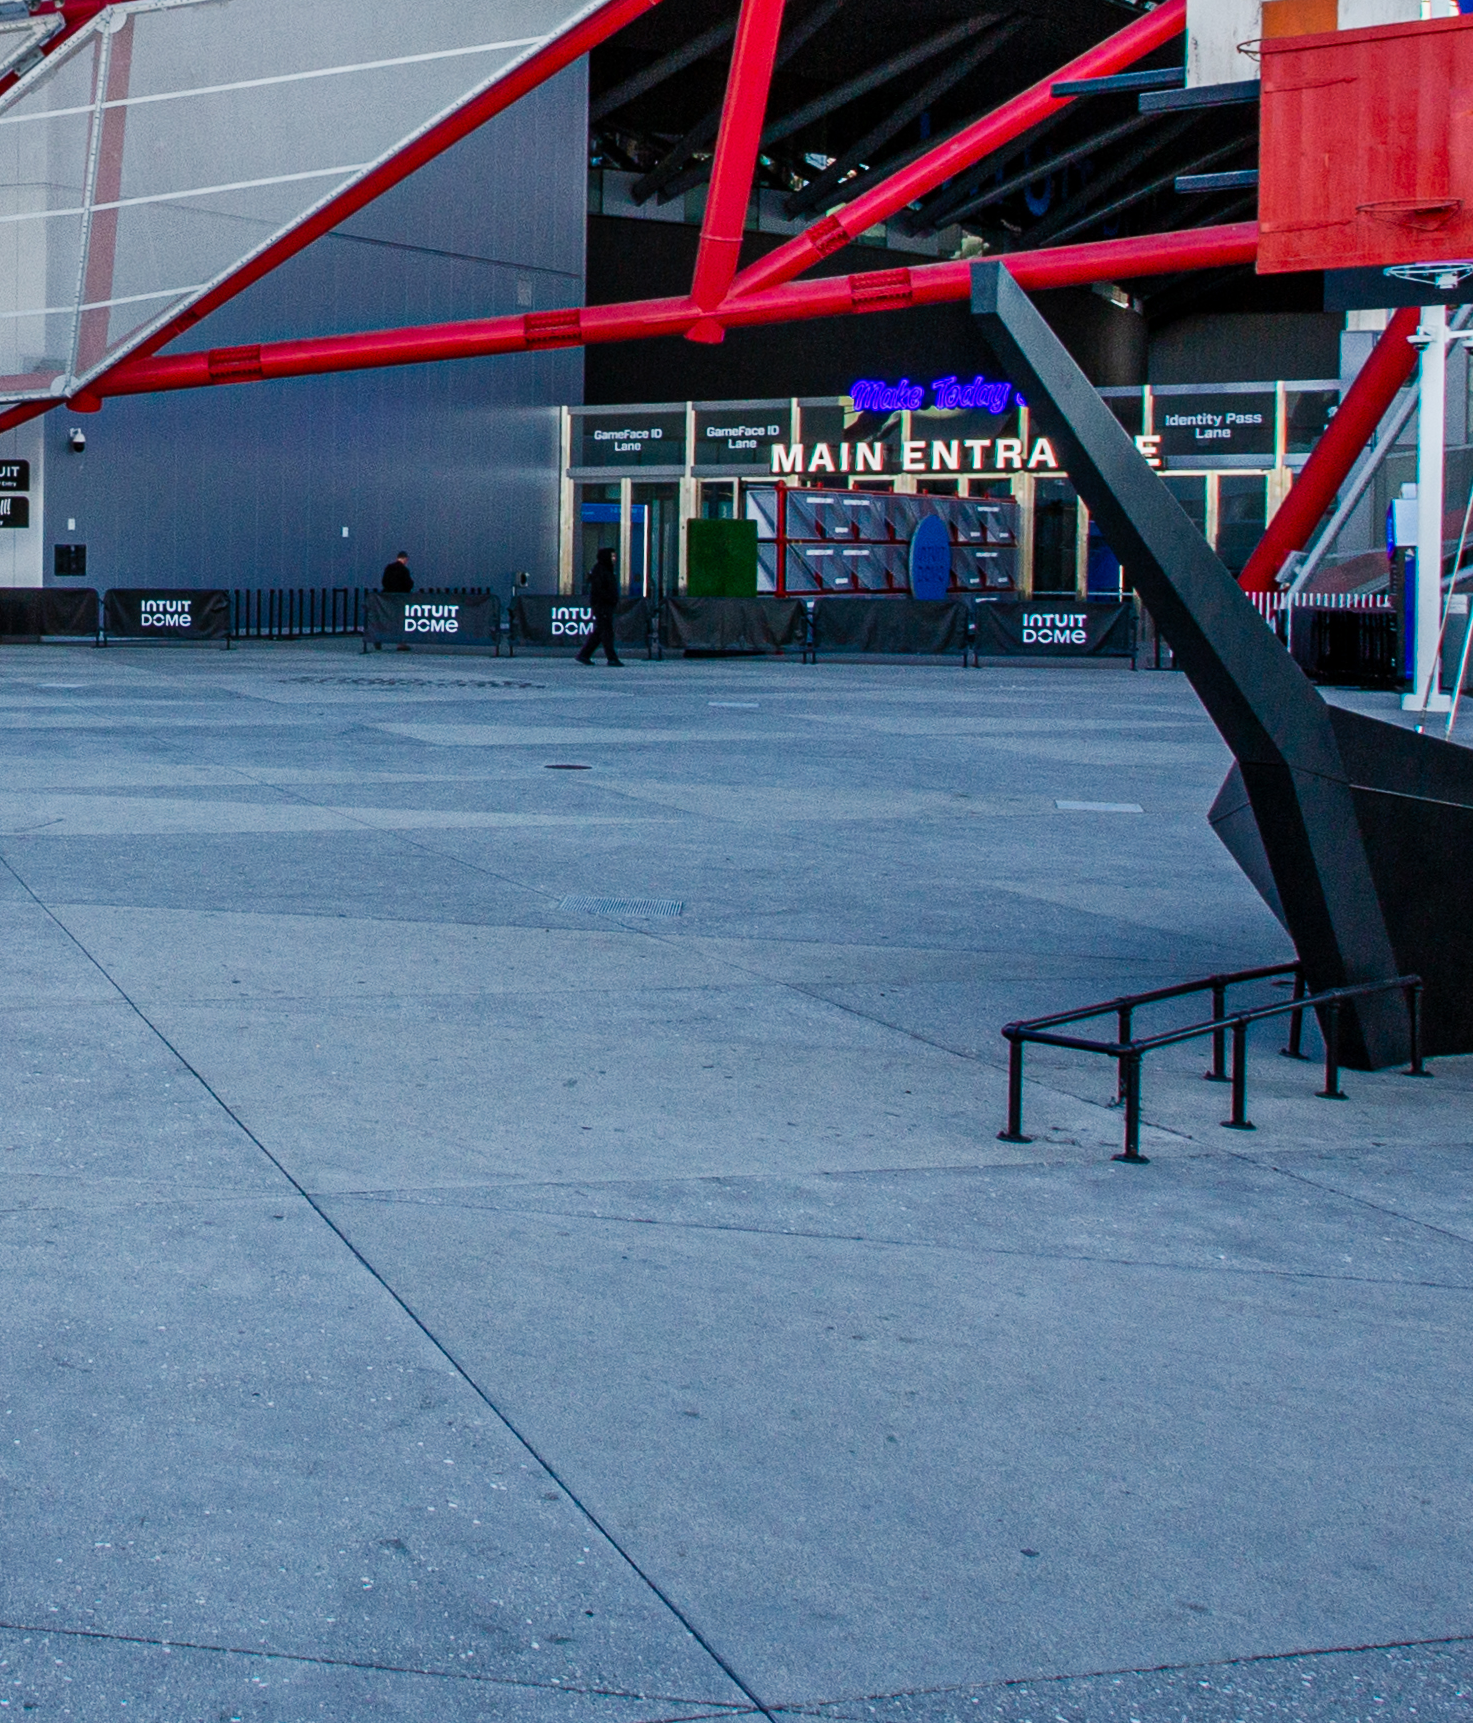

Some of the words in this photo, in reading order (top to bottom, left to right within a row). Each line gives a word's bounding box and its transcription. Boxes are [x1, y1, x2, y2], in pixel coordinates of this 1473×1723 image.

[851, 377, 924, 411] Make
[931, 375, 1012, 414] Today
[1165, 413, 1222, 427] Identity
[1225, 412, 1262, 424] Pass
[594, 429, 649, 441] GameFace
[650, 428, 663, 439] ID
[707, 426, 765, 438] GameFace
[767, 425, 780, 436] ID
[1195, 428, 1231, 439] Lane
[614, 441, 642, 451] Lane
[728, 438, 757, 449] Lane
[771, 442, 883, 473] MAIN
[902, 435, 1162, 471] ENTRAE
[551, 607, 596, 620] INTU
[551, 622, 594, 635] DOM
